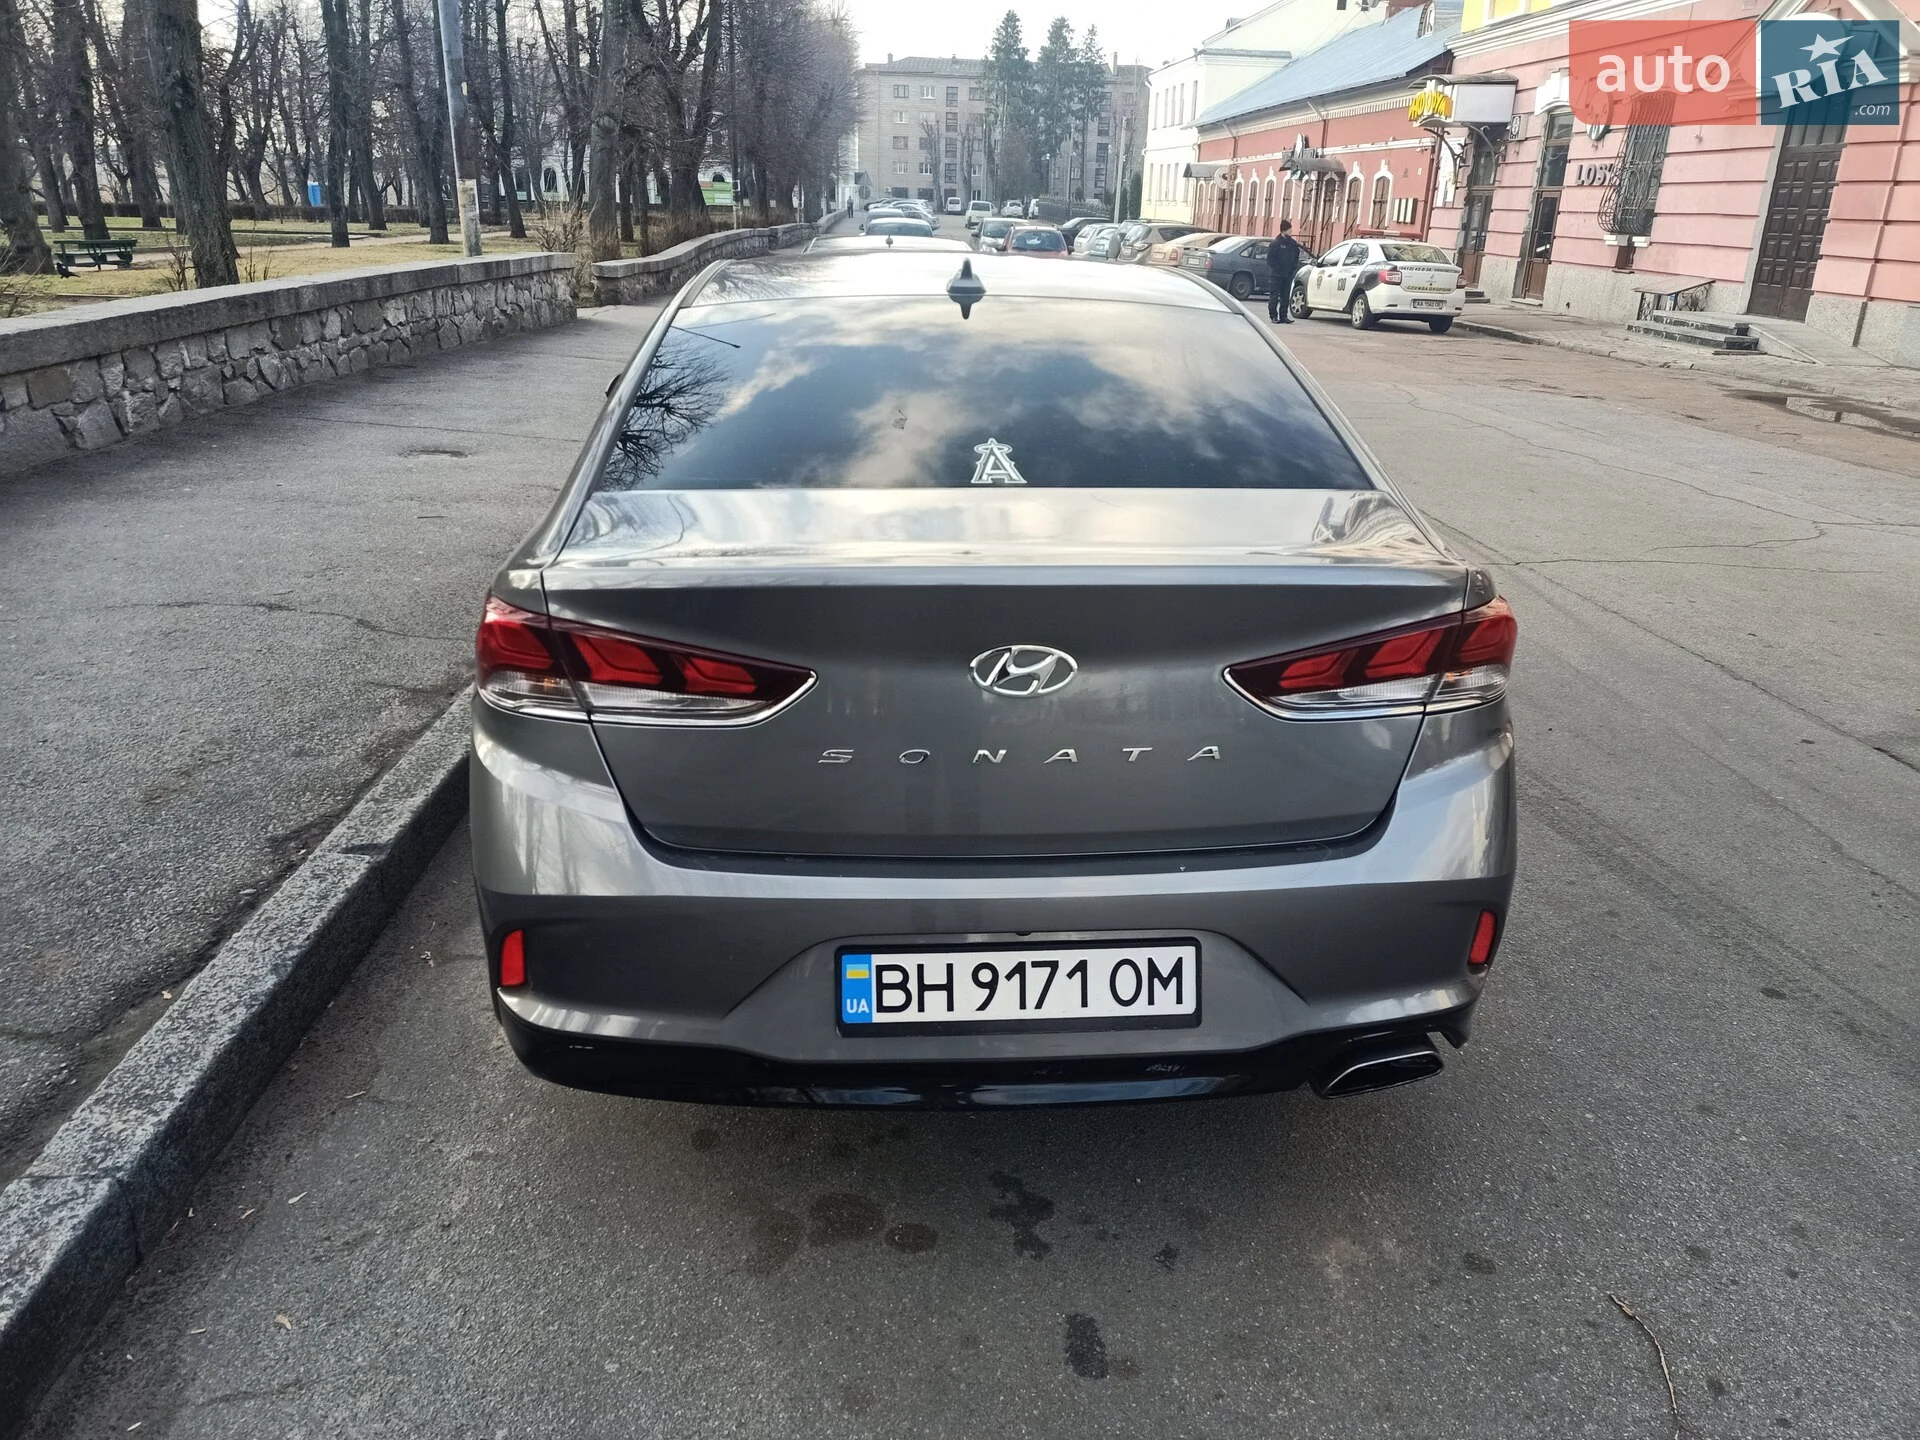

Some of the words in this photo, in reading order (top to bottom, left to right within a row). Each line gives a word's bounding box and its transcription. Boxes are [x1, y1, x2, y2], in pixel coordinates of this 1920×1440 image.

[817, 745, 1222, 764] SONATA
[874, 962, 954, 1013] BH
[971, 958, 1088, 1011] 9171
[1109, 955, 1184, 1008] OM
[846, 998, 870, 1014] UA
